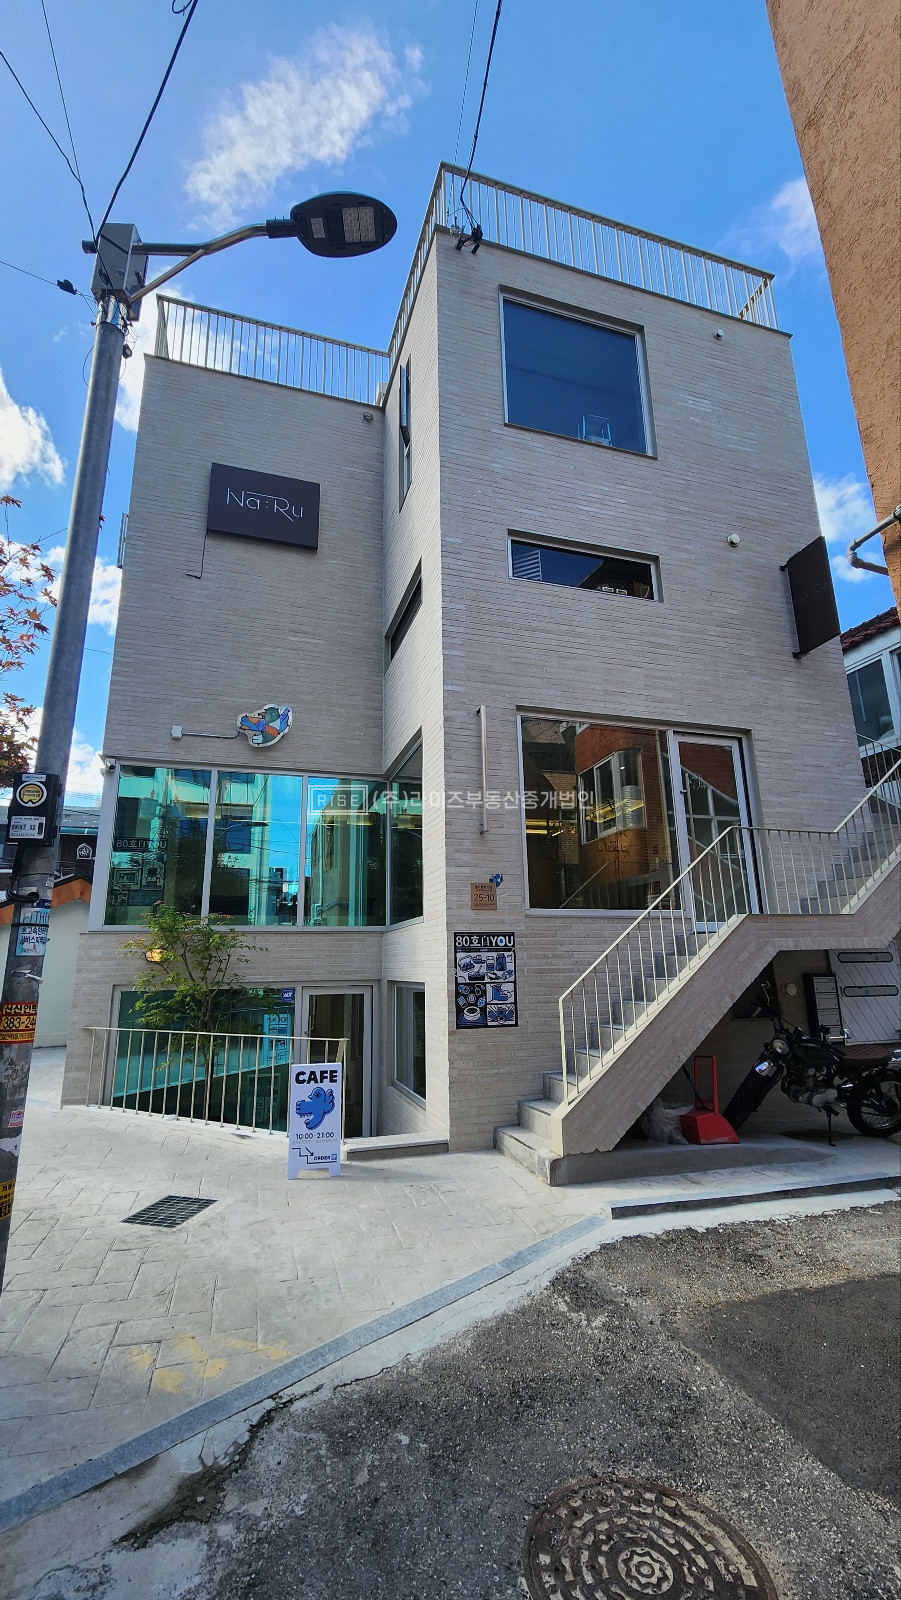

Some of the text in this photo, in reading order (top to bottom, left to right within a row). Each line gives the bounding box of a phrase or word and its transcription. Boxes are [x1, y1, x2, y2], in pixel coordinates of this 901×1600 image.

[226, 487, 304, 523] Na:Ru
[473, 893, 495, 902] 25-10
[294, 1069, 338, 1085] CAFE
